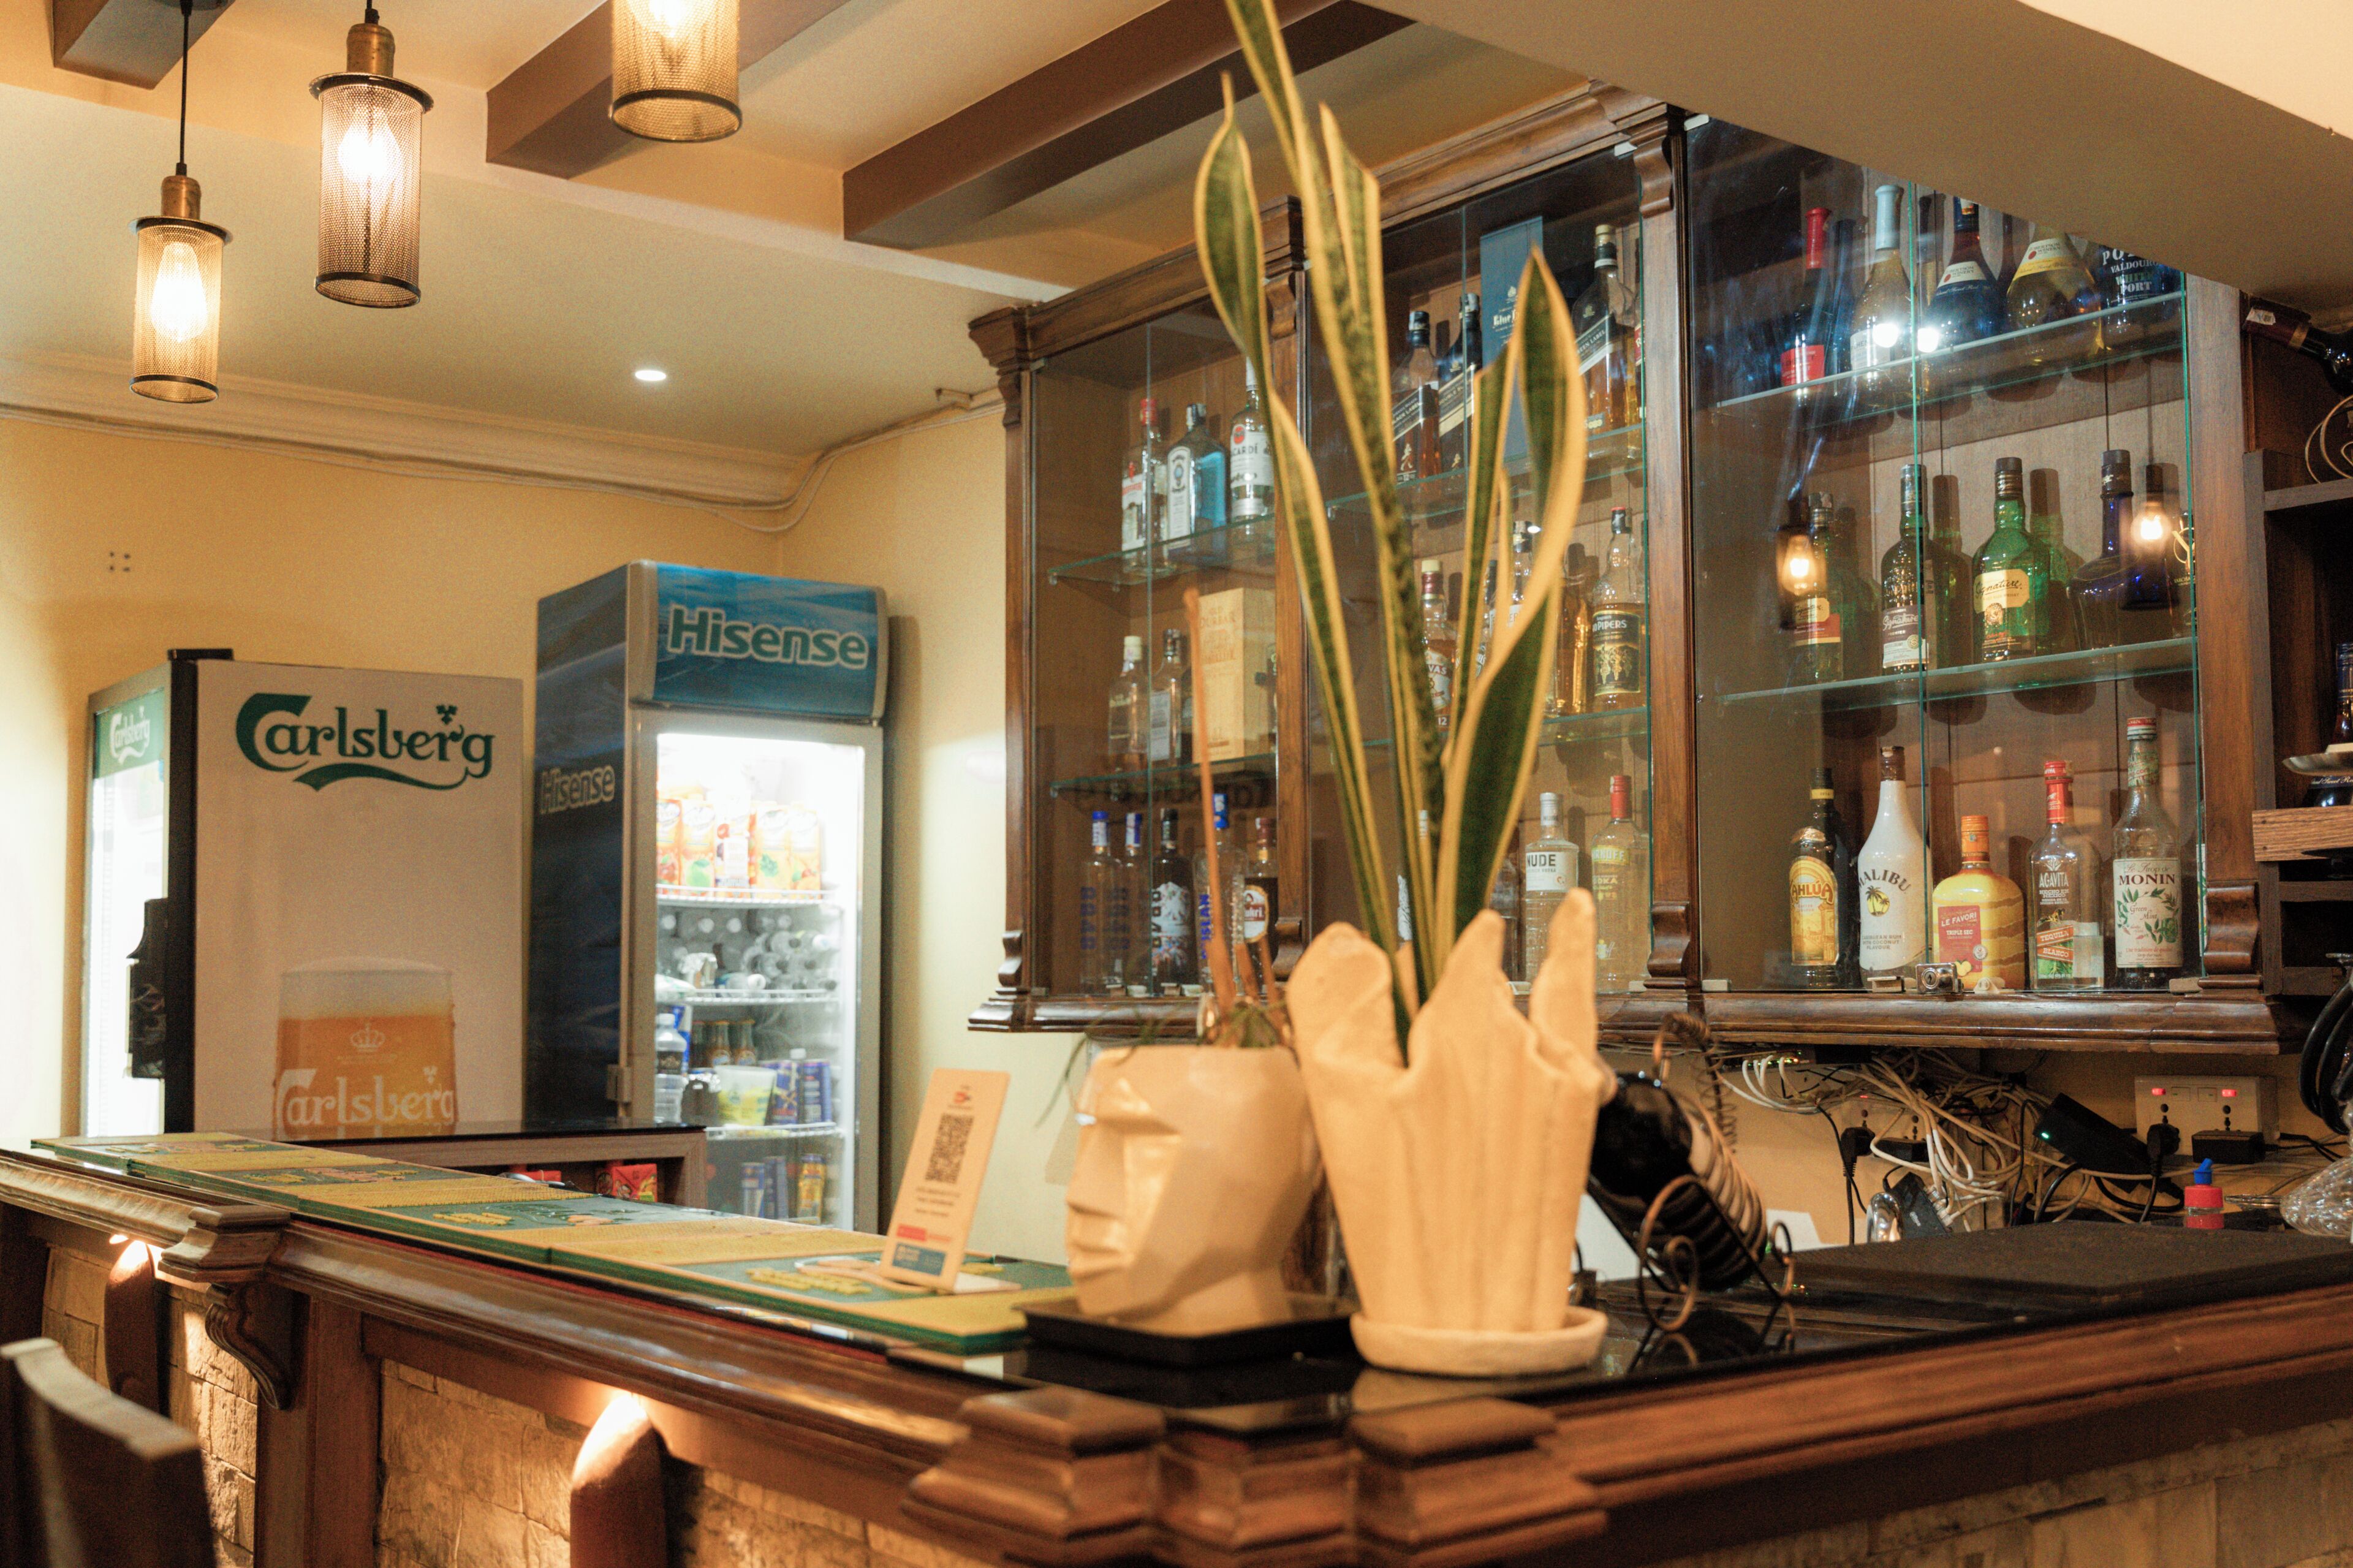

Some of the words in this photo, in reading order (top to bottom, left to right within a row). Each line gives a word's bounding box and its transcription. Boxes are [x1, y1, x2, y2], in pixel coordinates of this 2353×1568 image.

[2121, 281, 2151, 294] PORT
[1232, 444, 1258, 456] CARDÍ
[1597, 619, 1627, 631] PIPERS
[1882, 613, 1919, 631] Signature
[667, 603, 870, 670] Hisense
[1428, 665, 1447, 675] VAS
[1438, 717, 1447, 725] 12
[109, 708, 151, 761] Carlsberg
[235, 692, 496, 789] Carlsberg
[539, 765, 615, 815] Hisense
[1859, 869, 1911, 891] MALIBU
[2039, 872, 2069, 888] AGAVITA
[2119, 874, 2175, 885] MONIN
[1790, 879, 1834, 904] AHLÚA
[1952, 912, 1977, 925] FAVORI
[2040, 930, 2069, 942] TEQUILA
[2043, 947, 2069, 958] BLANCO
[276, 1067, 454, 1137] Carlsberg
